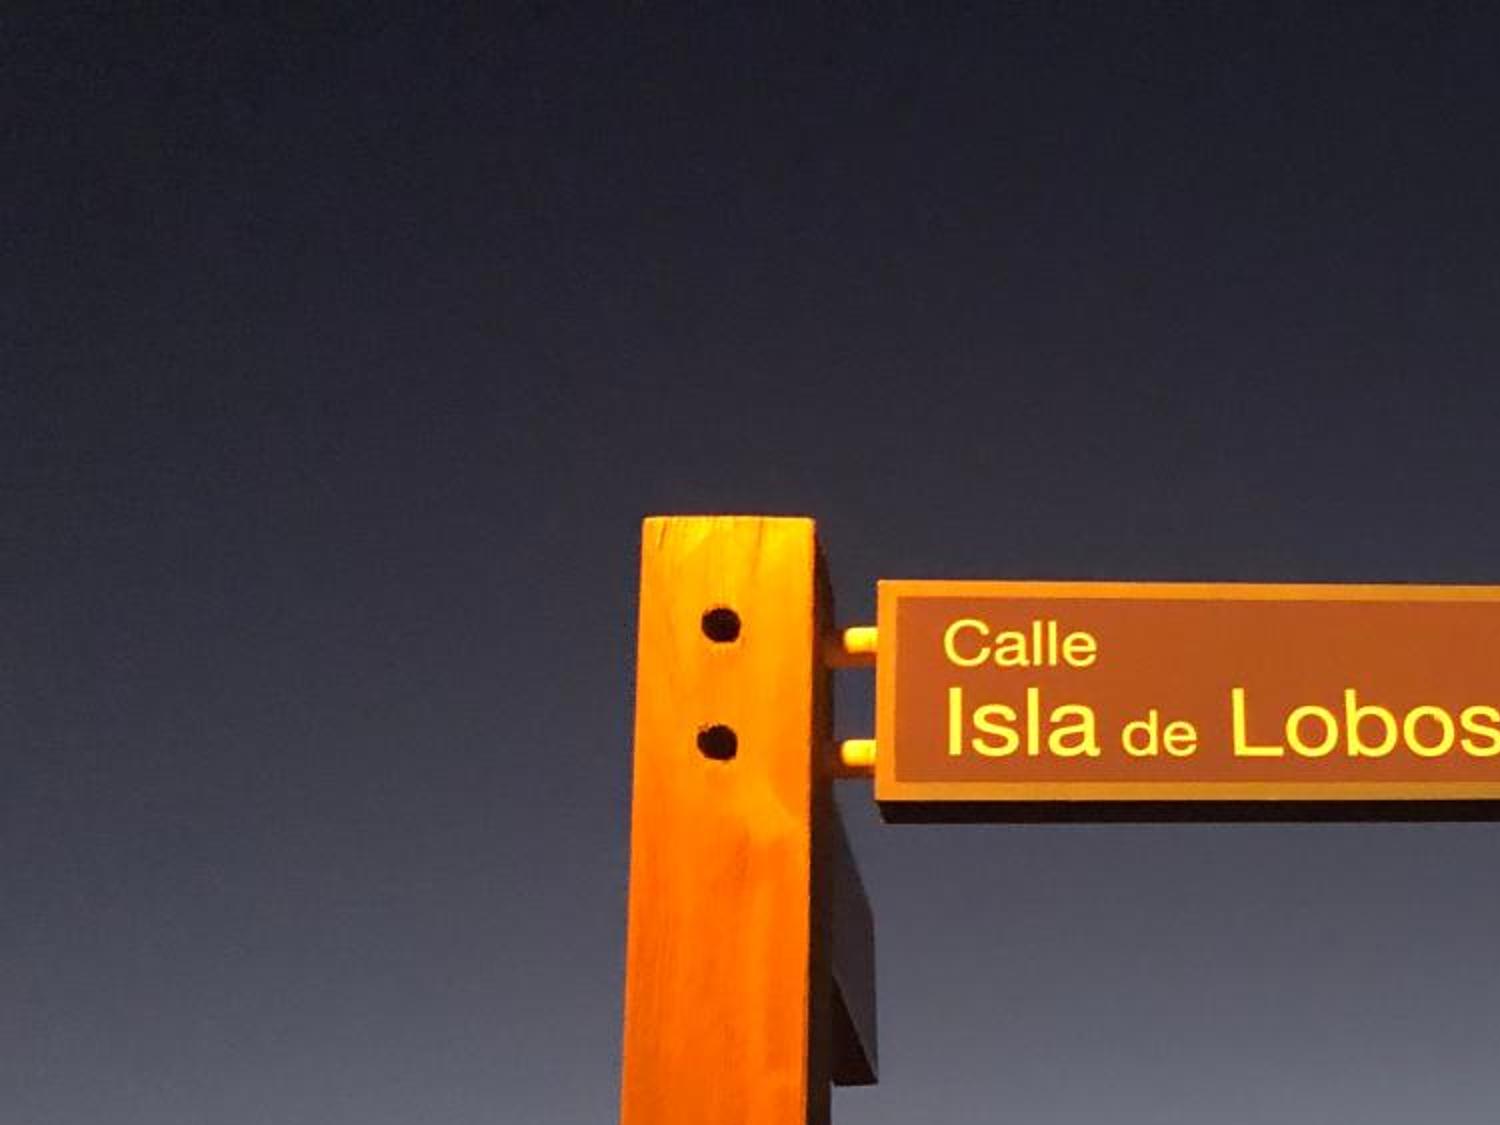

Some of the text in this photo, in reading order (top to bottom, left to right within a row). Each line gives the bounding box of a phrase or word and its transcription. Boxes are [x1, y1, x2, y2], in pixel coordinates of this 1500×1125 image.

[943, 618, 1097, 667] Calle
[947, 686, 1101, 757] Isla
[1121, 709, 1198, 757] de
